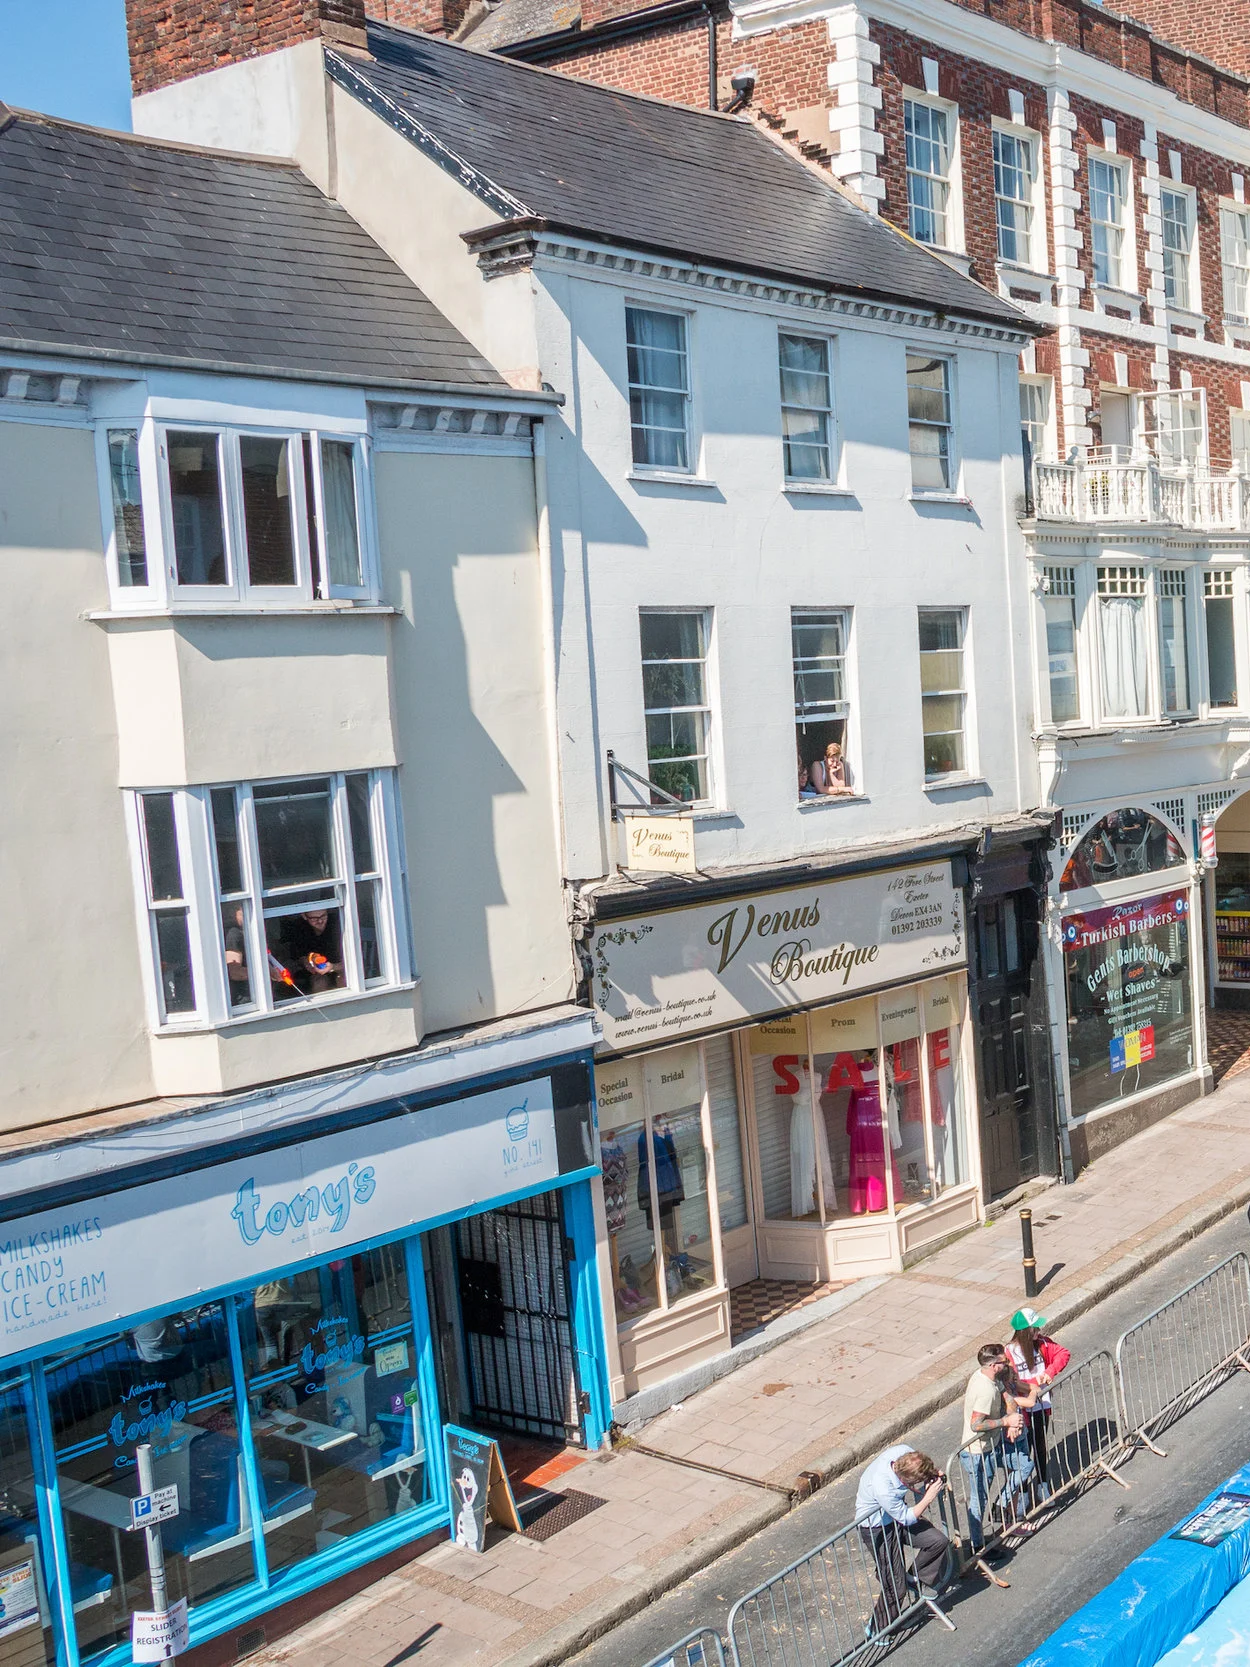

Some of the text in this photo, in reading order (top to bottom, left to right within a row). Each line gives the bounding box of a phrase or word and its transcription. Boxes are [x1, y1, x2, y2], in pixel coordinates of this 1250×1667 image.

[632, 828, 673, 847] Venus
[649, 843, 689, 864] Boutique
[914, 906, 928, 917] EX4
[891, 915, 943, 936] 01392 203339
[707, 898, 820, 975] Venus
[770, 938, 880, 986] Boutique
[1087, 942, 1171, 993] Gents Barbershop
[932, 995, 950, 1007] Bridal
[831, 1018, 856, 1027] Prom
[881, 1006, 917, 1022] Eveningwear
[760, 1026, 796, 1035] Occasion
[600, 1078, 629, 1095] Special
[661, 1070, 685, 1084] Bridal
[598, 1092, 633, 1107] Occasion
[503, 1145, 523, 1166] NO.
[230, 1162, 376, 1246] tony's
[0, 1217, 103, 1266] MILKSHAKES
[2, 1256, 64, 1293] CANDY
[4, 1270, 106, 1322] ICE-CREAM
[6, 1296, 108, 1334] handmade here!
[301, 1334, 366, 1375] tony's
[120, 1381, 167, 1403] Milkshakes
[108, 1400, 186, 1447] tony's
[137, 1499, 148, 1515] P
[136, 1509, 177, 1527] Display ticket
[151, 1618, 177, 1632] SLIDER
